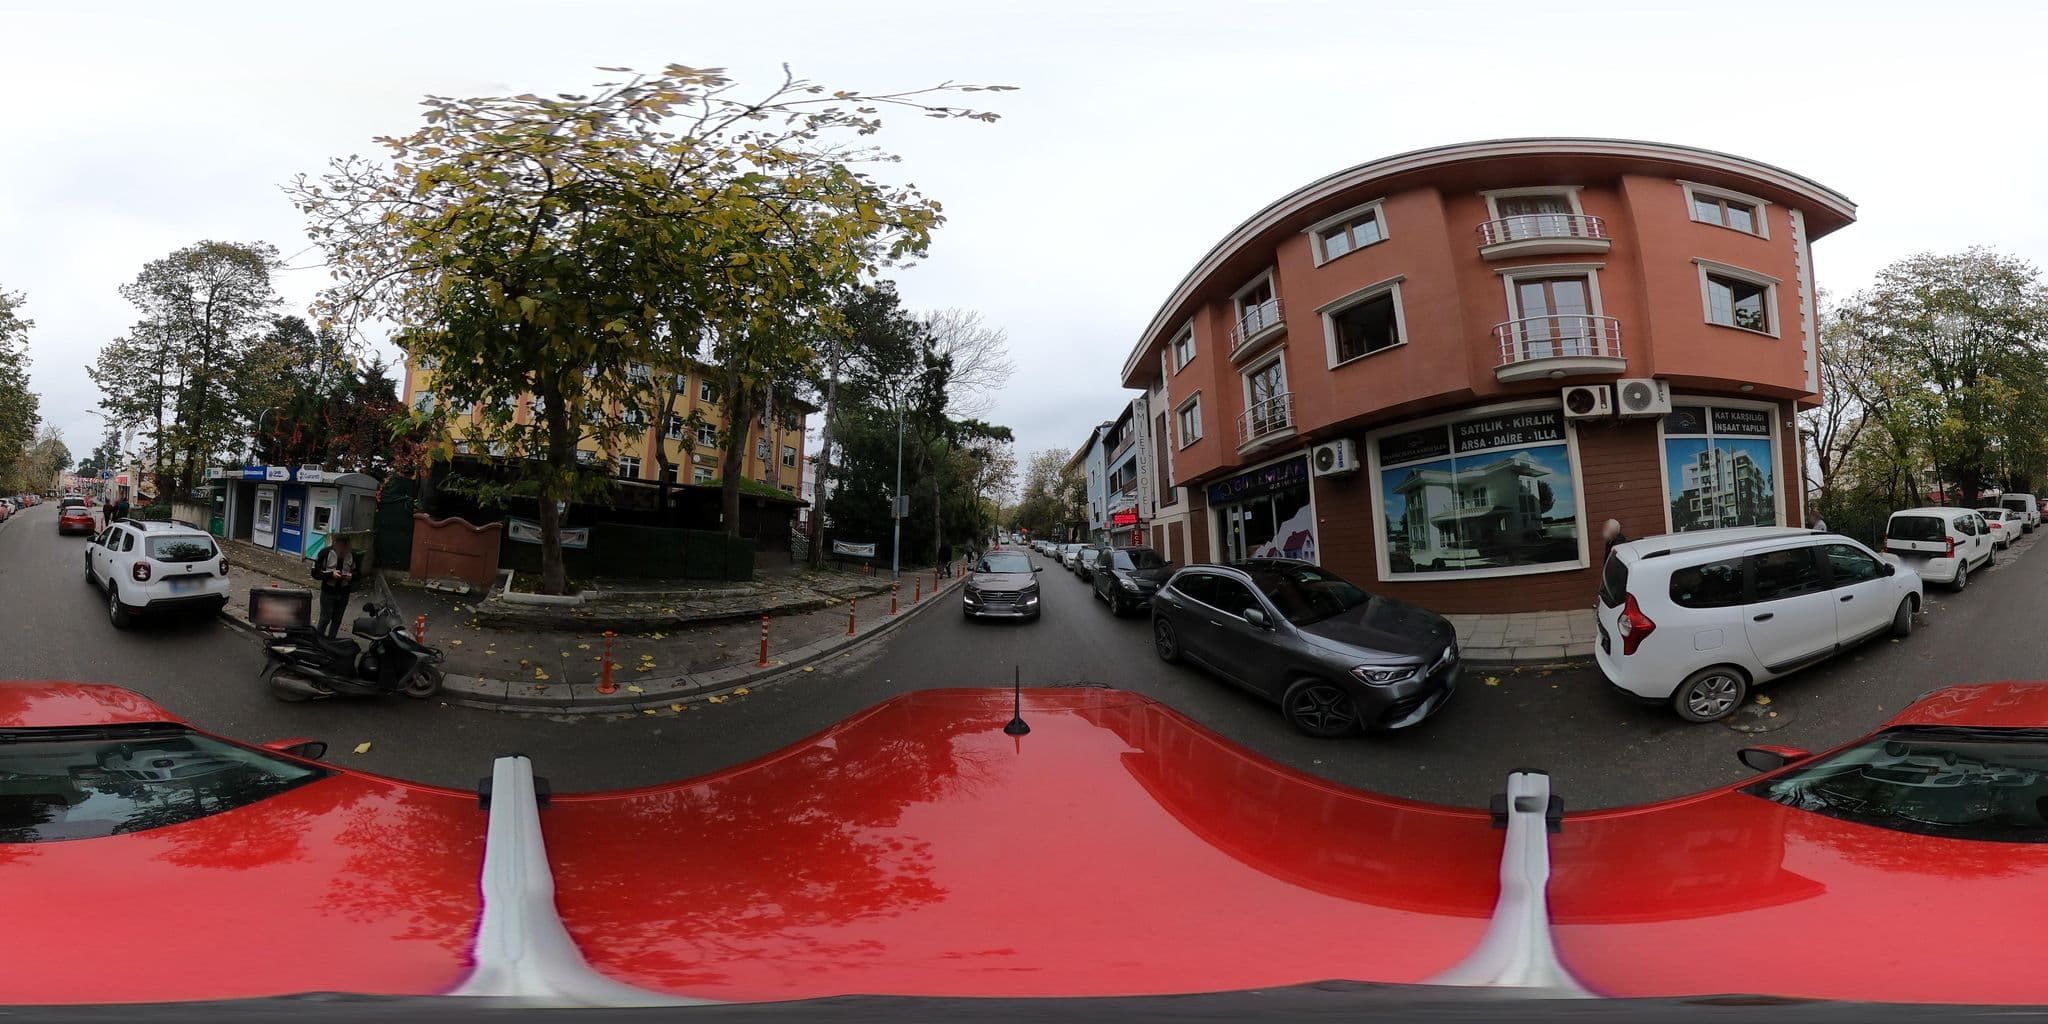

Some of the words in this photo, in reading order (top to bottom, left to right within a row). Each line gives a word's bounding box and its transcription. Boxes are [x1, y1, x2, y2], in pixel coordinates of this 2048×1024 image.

[1715, 412, 1729, 420] KAT
[1731, 412, 1765, 422] KARŞILIĞI
[1461, 421, 1503, 436] SATILIK
[1714, 421, 1740, 432] İNŞAAT
[1741, 424, 1766, 433] YAPILIR
[1137, 413, 1147, 474] MILETUS
[1461, 438, 1486, 450] ARSA
[1494, 432, 1523, 446] DAİRE
[1141, 480, 1149, 515] OTEL
